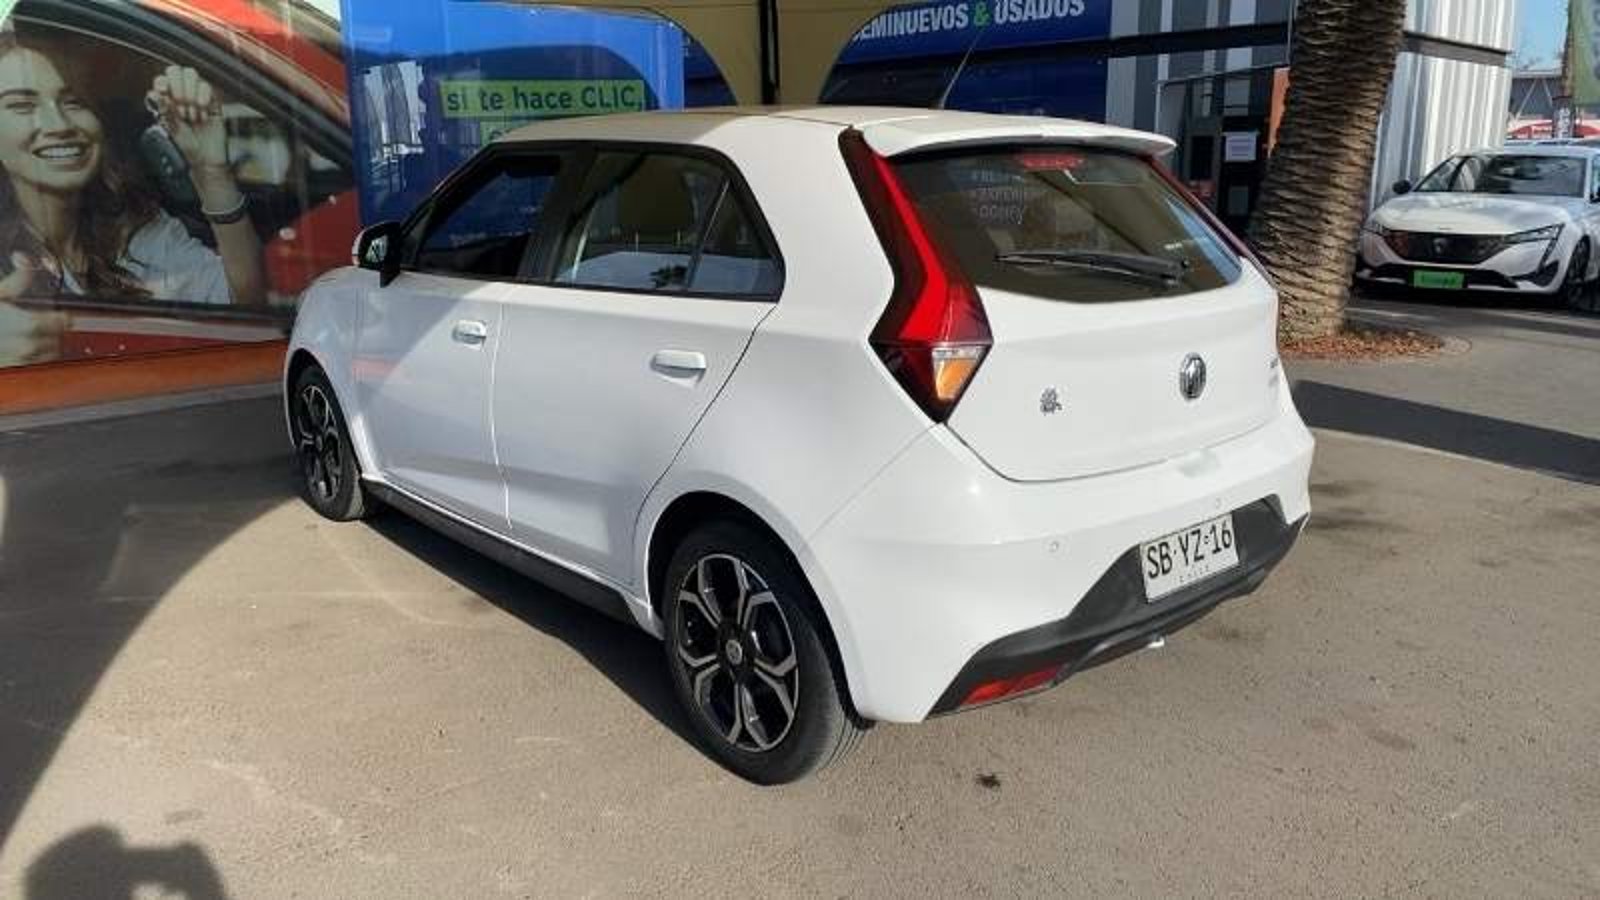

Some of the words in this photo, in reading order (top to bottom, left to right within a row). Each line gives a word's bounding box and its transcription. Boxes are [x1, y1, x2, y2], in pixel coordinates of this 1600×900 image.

[973, 2, 990, 26] &
[995, 0, 1085, 24] USADOS
[447, 90, 468, 111] si
[480, 89, 504, 111] te
[513, 86, 572, 109] hace
